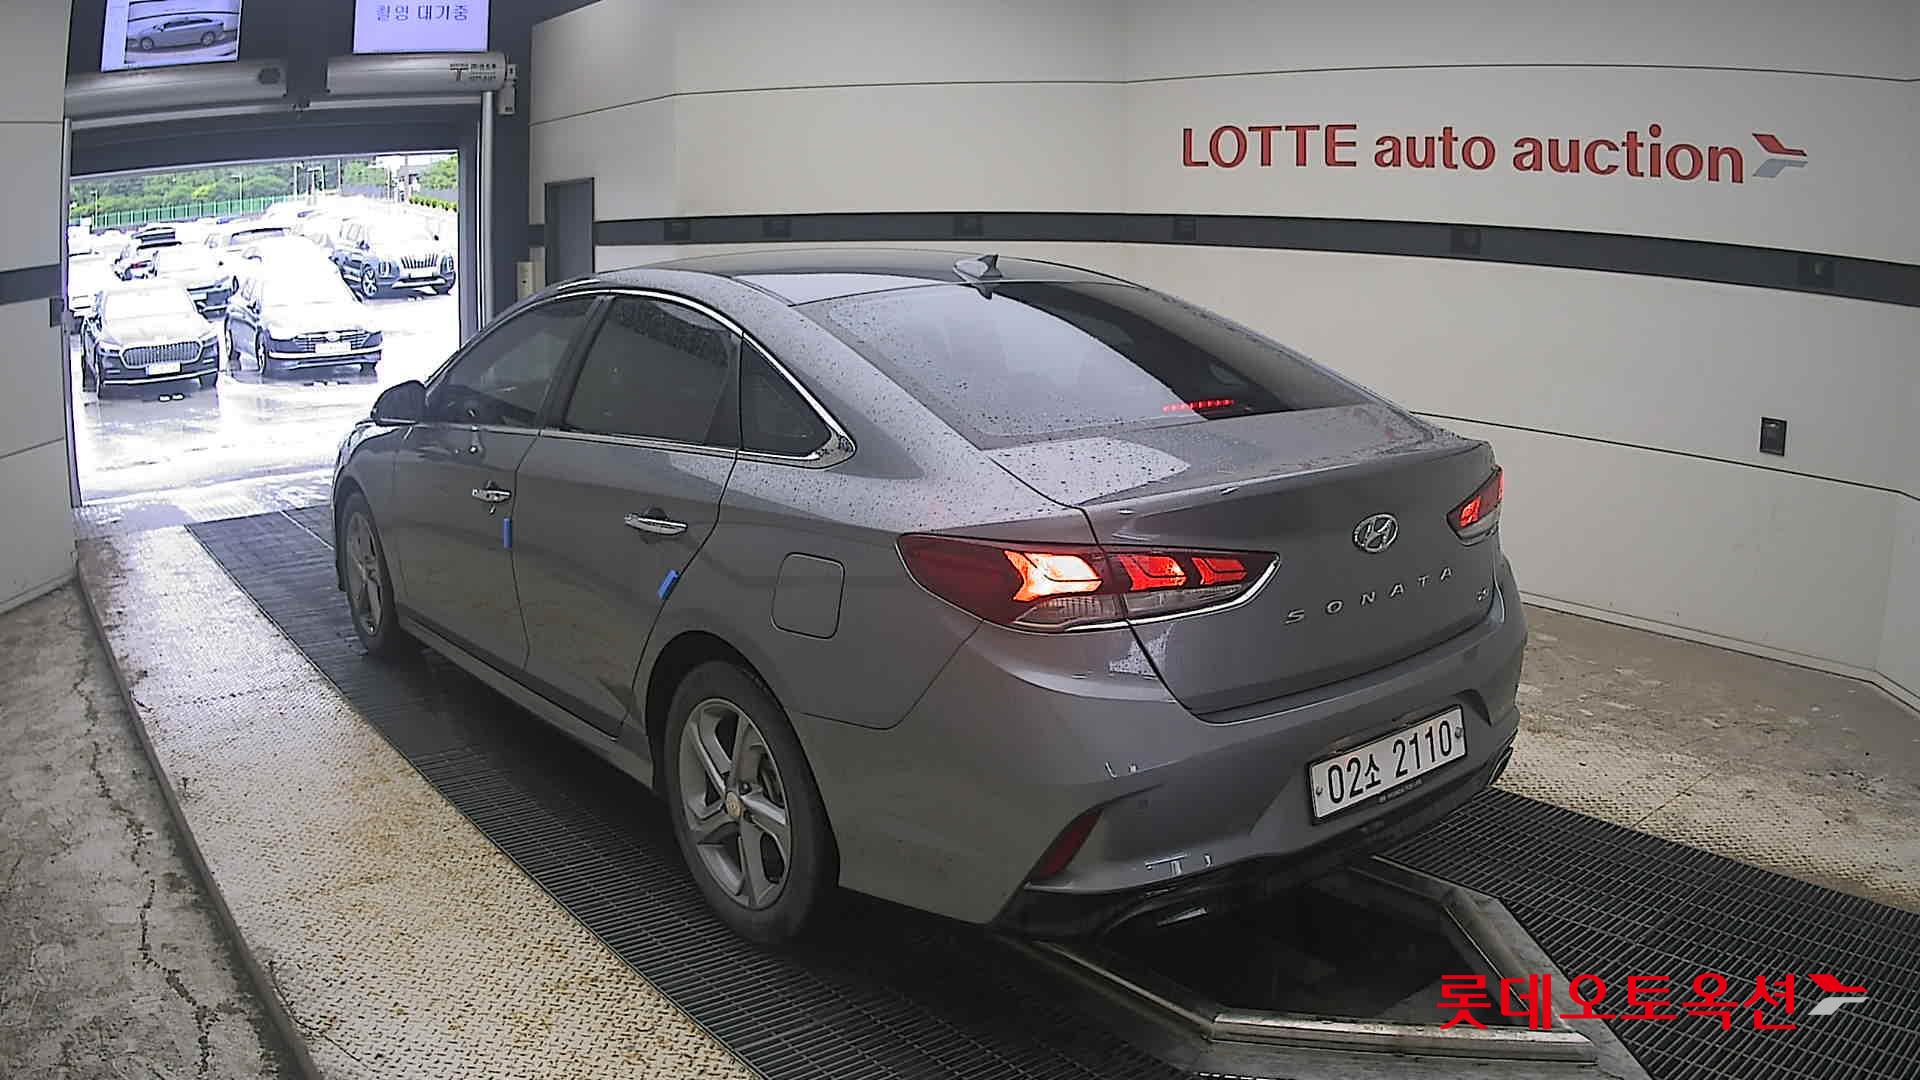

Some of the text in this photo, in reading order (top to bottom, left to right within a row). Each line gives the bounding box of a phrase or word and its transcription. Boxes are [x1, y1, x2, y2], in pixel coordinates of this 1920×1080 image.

[417, 4, 469, 22] 대기중
[1183, 123, 1744, 184] LOTTE auto auction
[1283, 566, 1455, 625] SONATA
[1327, 753, 1382, 804] 02소
[1392, 719, 1453, 778] 2110
